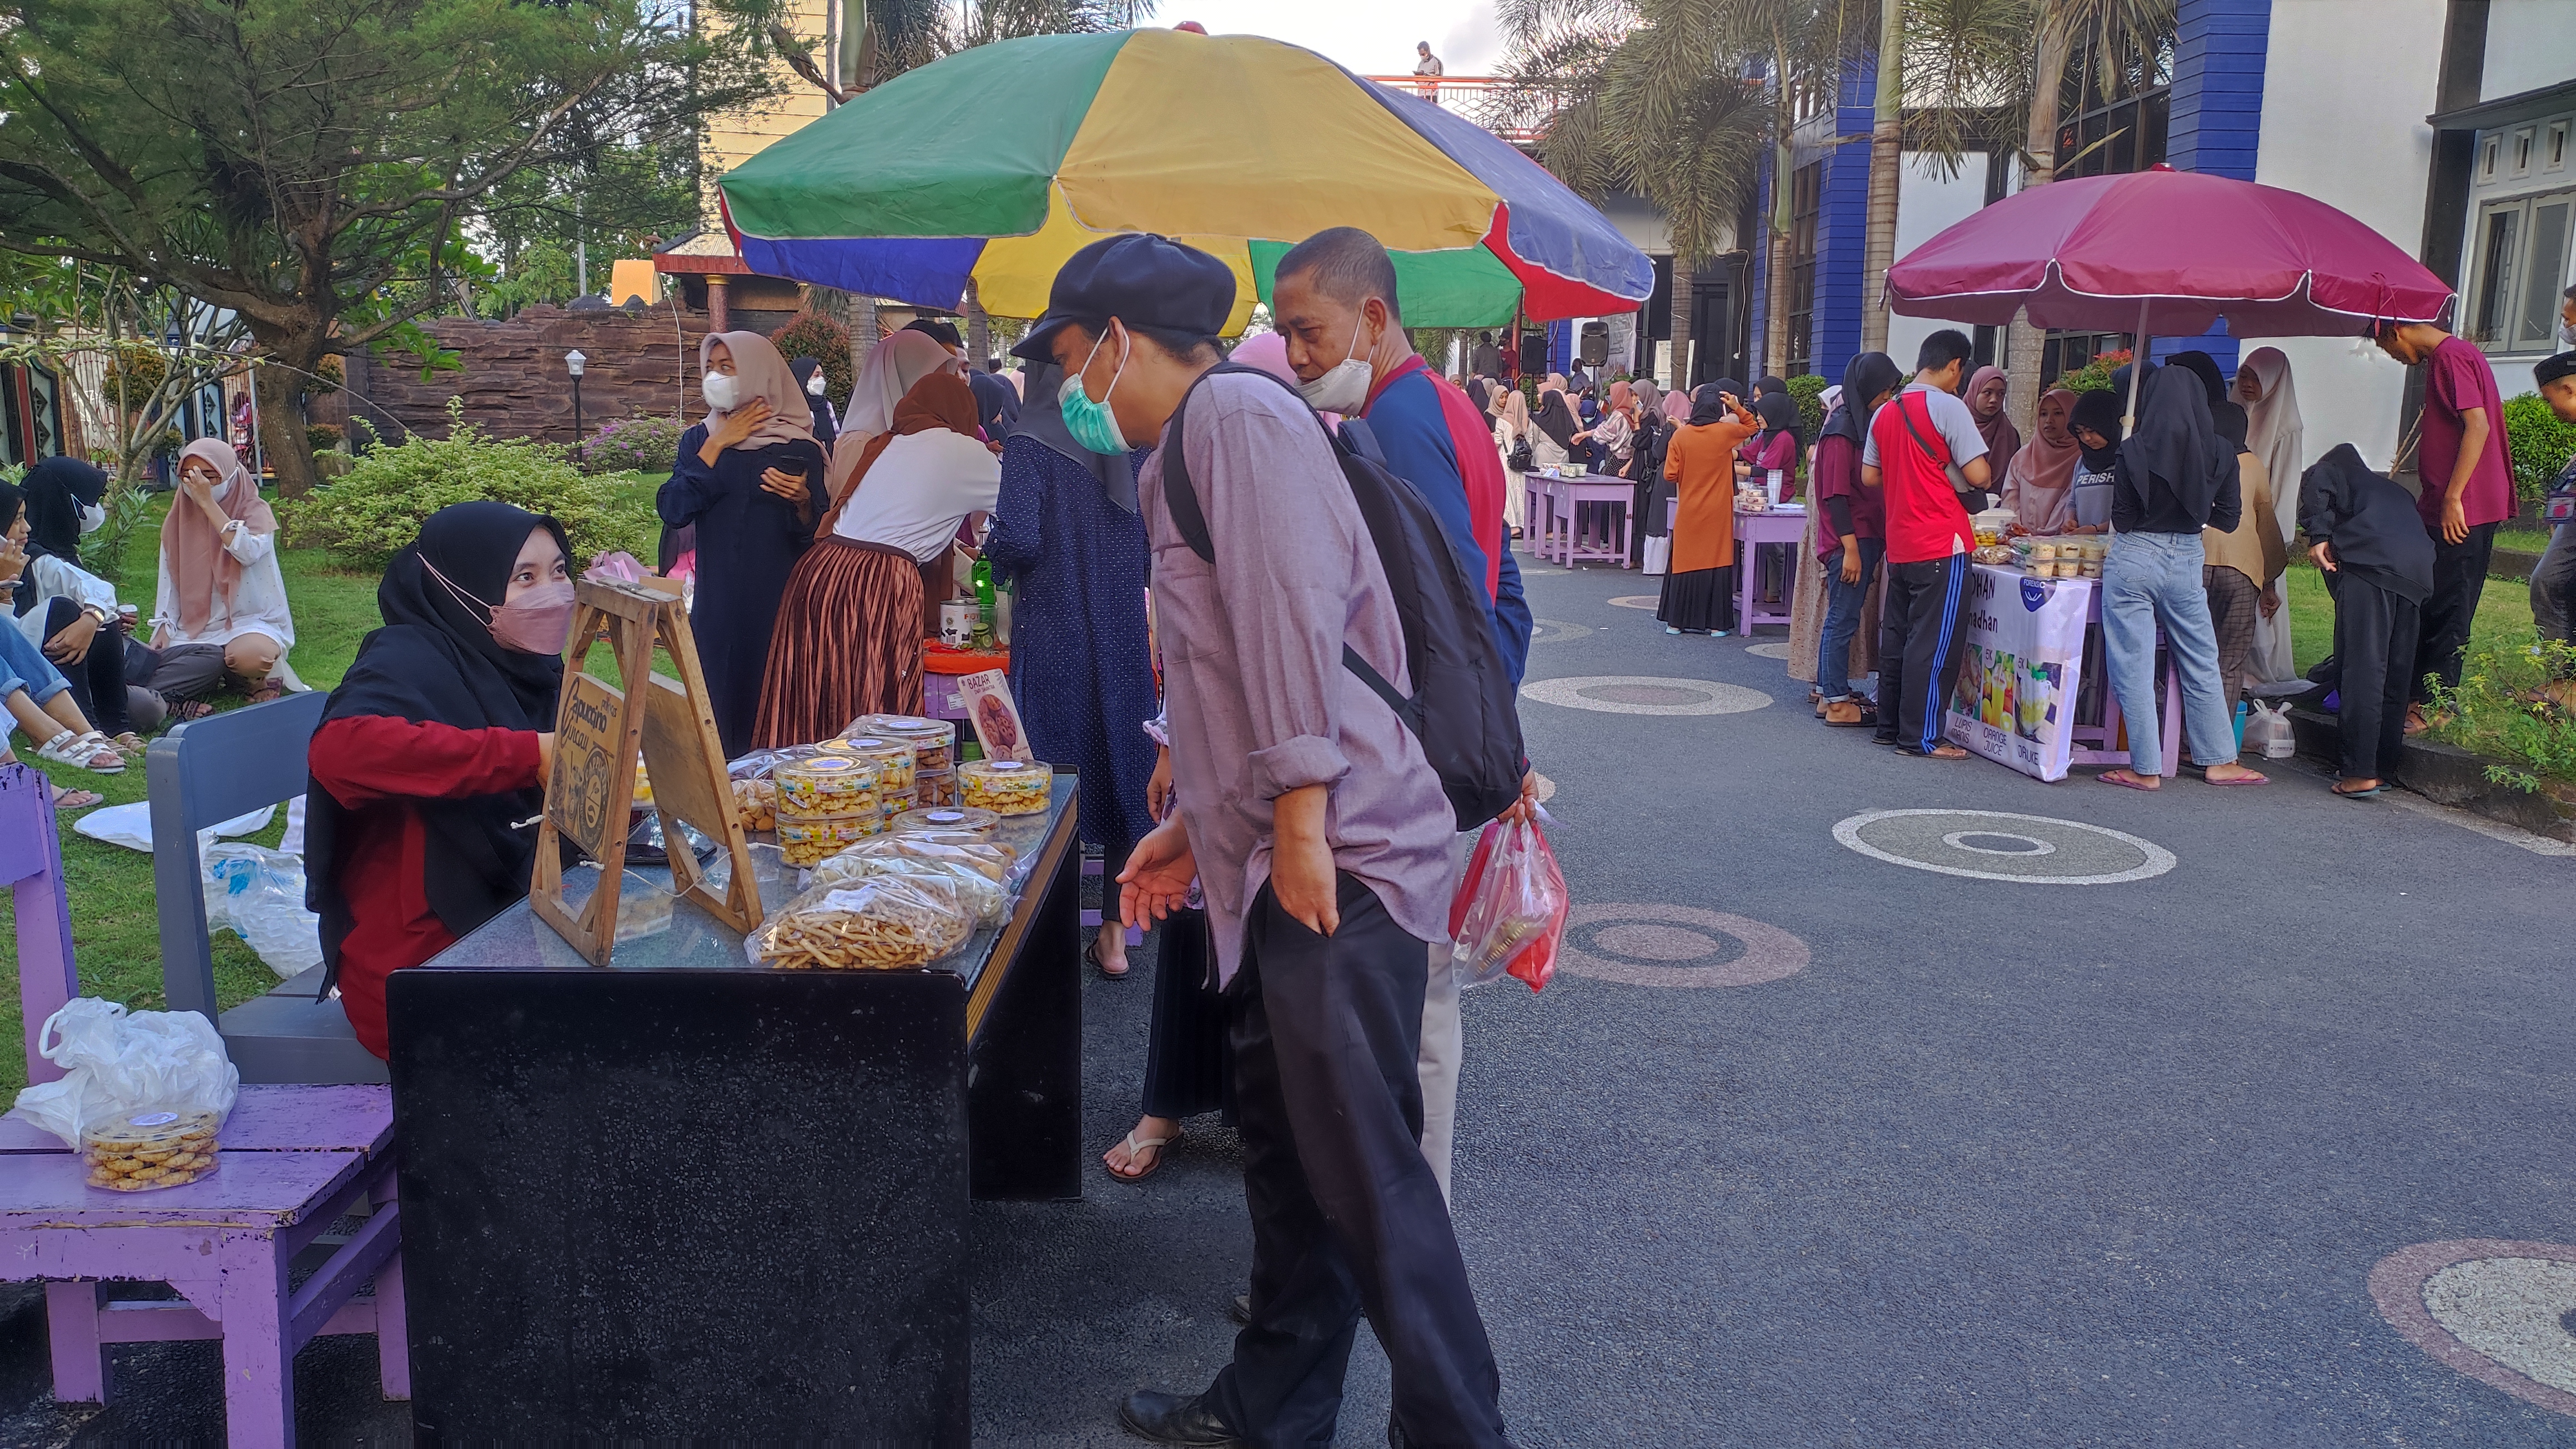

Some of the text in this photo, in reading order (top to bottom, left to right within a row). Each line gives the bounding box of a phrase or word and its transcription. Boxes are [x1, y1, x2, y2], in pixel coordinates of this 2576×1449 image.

[2024, 578, 2046, 588] FORENSIC
[1986, 648, 1993, 661] 5K
[2018, 657, 2025, 670] 5K
[967, 673, 991, 690] BAZAR
[1955, 717, 1973, 732] LUPIS
[1951, 728, 1970, 744] MANIS
[1983, 727, 2007, 746] ORANGE
[1984, 740, 2003, 756] JUICE
